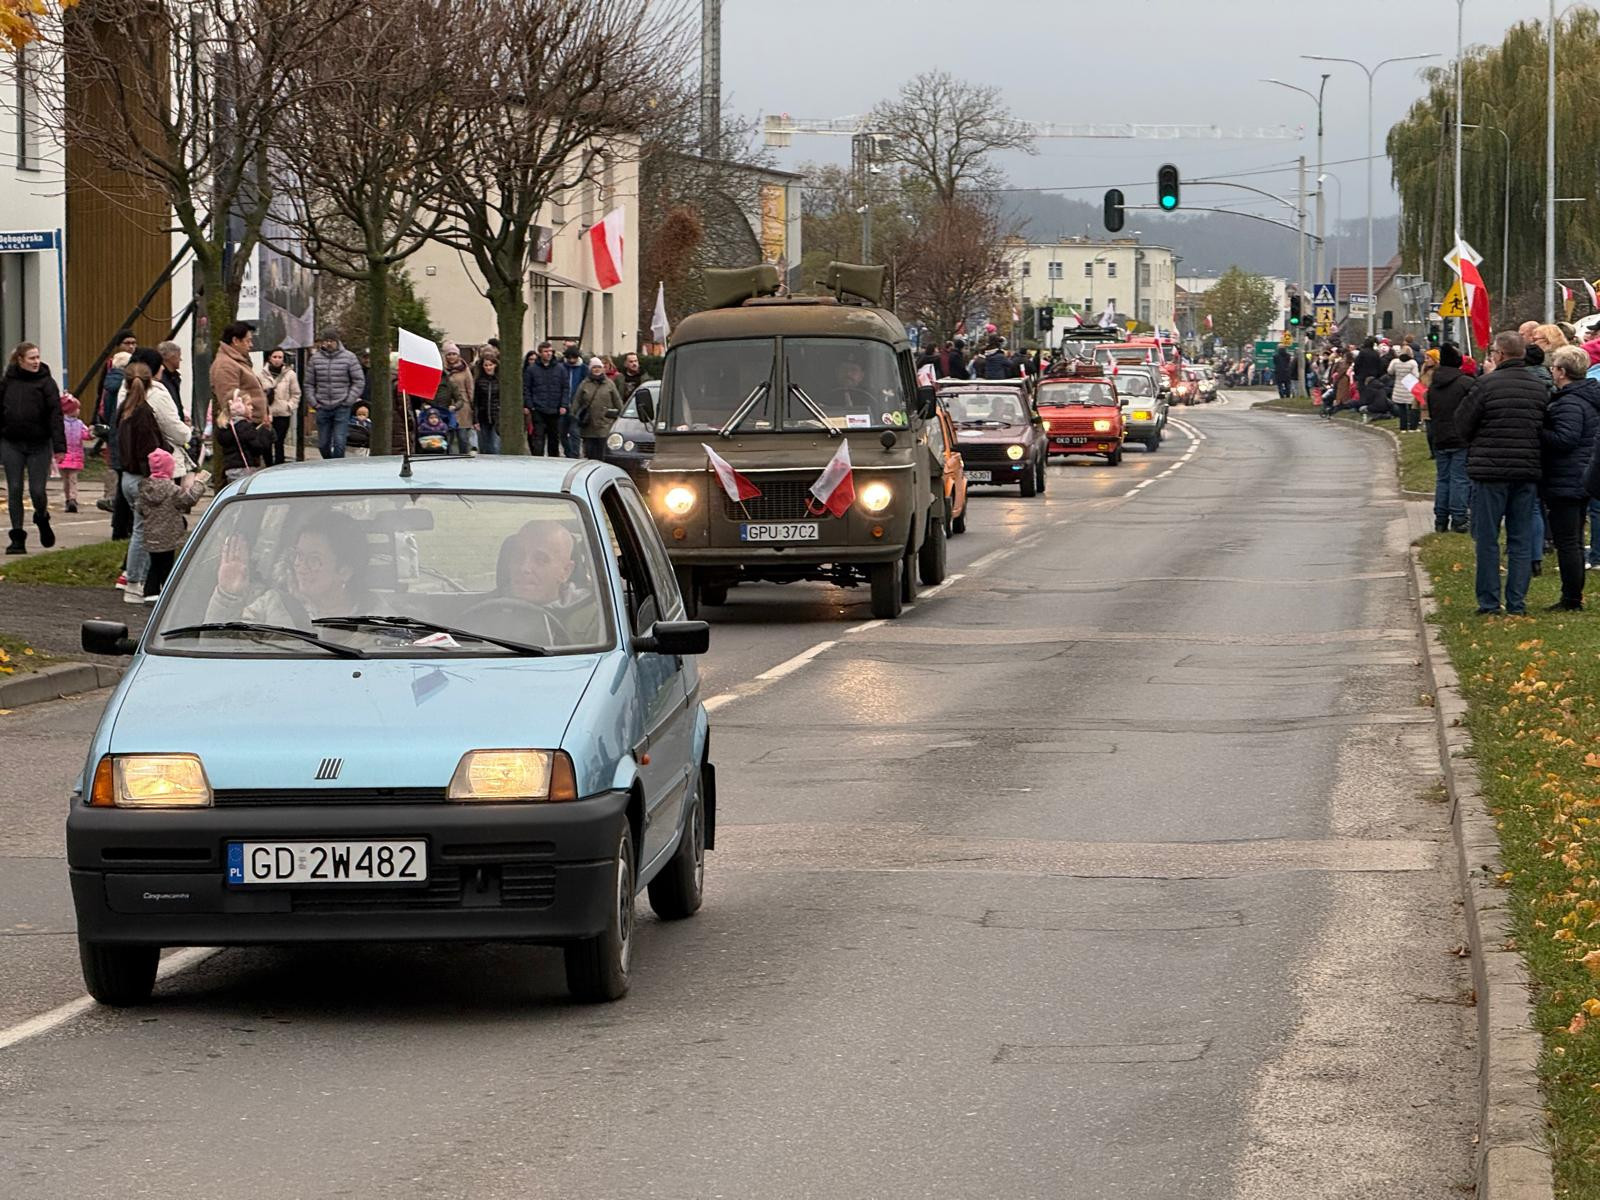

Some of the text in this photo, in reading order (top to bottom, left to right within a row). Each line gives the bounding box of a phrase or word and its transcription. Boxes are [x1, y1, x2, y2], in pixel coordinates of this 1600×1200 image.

[749, 525, 816, 539] GPU 37C2
[251, 846, 417, 879] GD 2W482
[230, 868, 242, 877] PL
